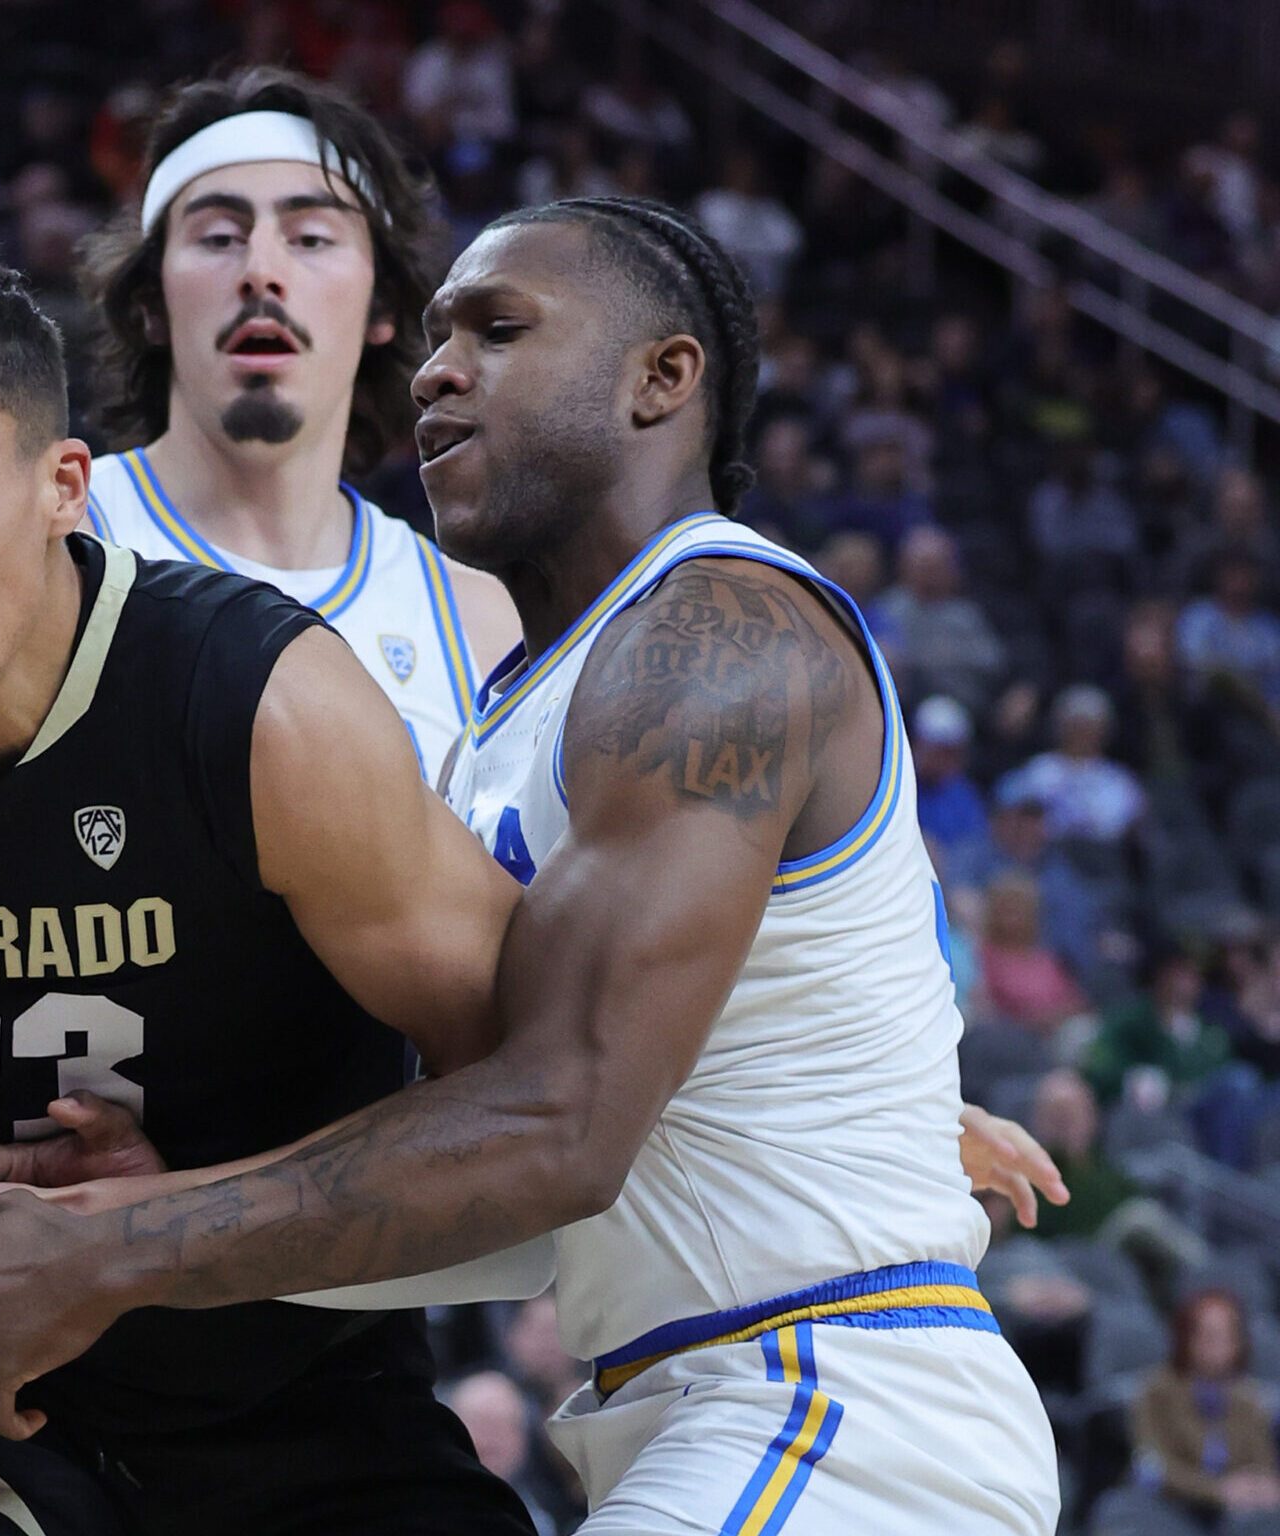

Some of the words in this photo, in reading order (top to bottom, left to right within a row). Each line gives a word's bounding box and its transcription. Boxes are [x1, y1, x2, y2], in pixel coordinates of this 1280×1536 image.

[683, 737, 772, 801] LAX
[78, 808, 122, 845] PAC
[91, 833, 115, 856] 12
